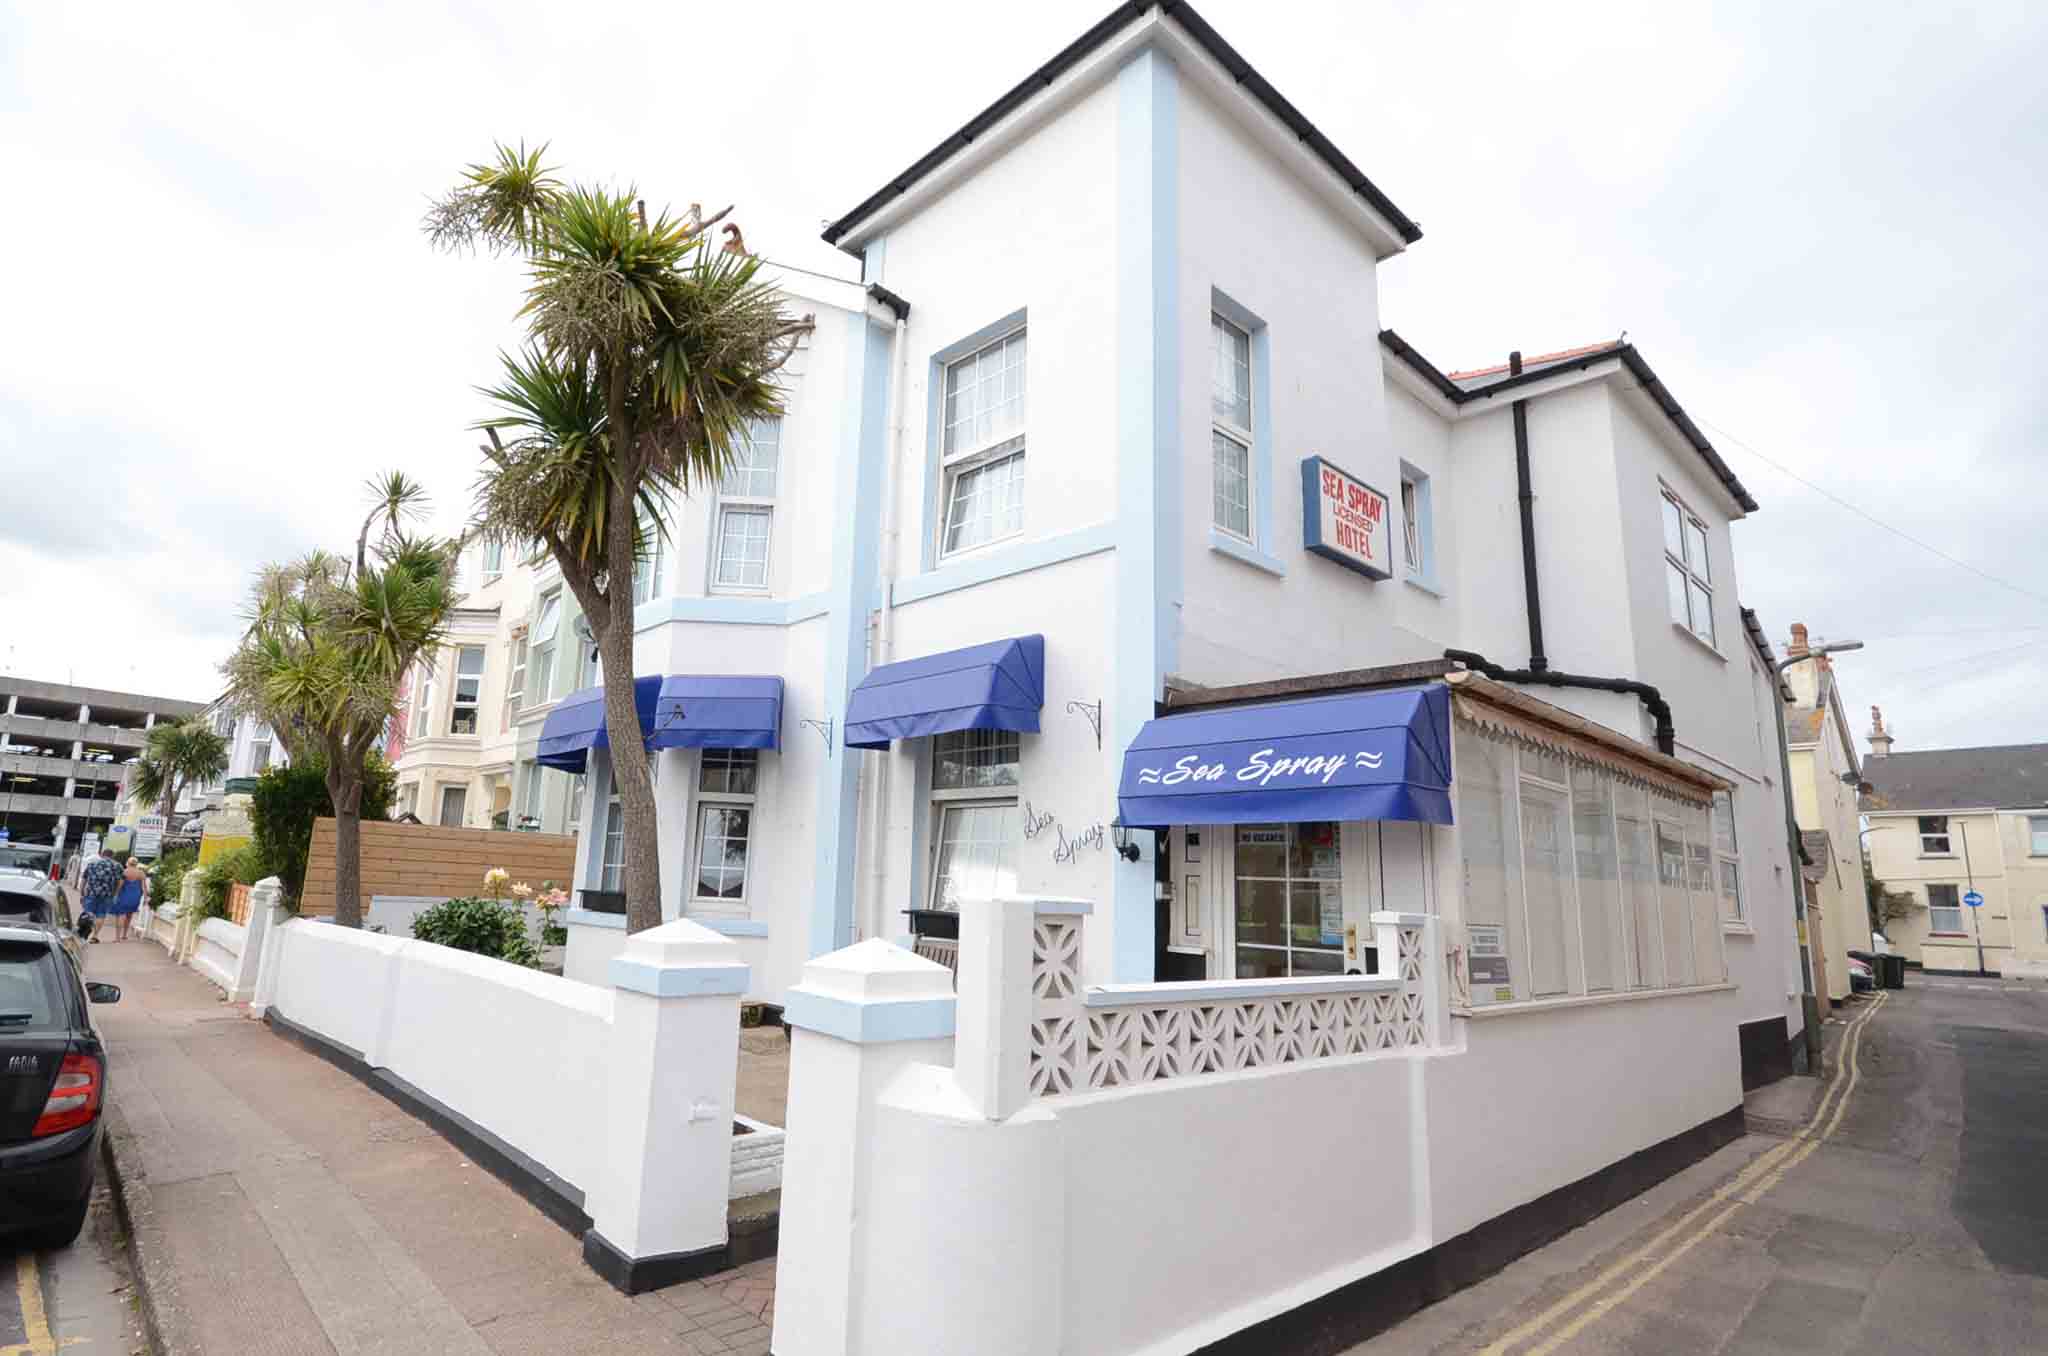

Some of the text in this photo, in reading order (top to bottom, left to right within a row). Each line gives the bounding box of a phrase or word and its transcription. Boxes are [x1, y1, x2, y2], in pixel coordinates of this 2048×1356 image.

[1322, 469, 1382, 523] SEA SPRAY
[1336, 519, 1372, 560] HOTEL
[1162, 748, 1348, 785] Sea Spray
[1023, 800, 1054, 840] Sea
[1053, 823, 1104, 865] Spray
